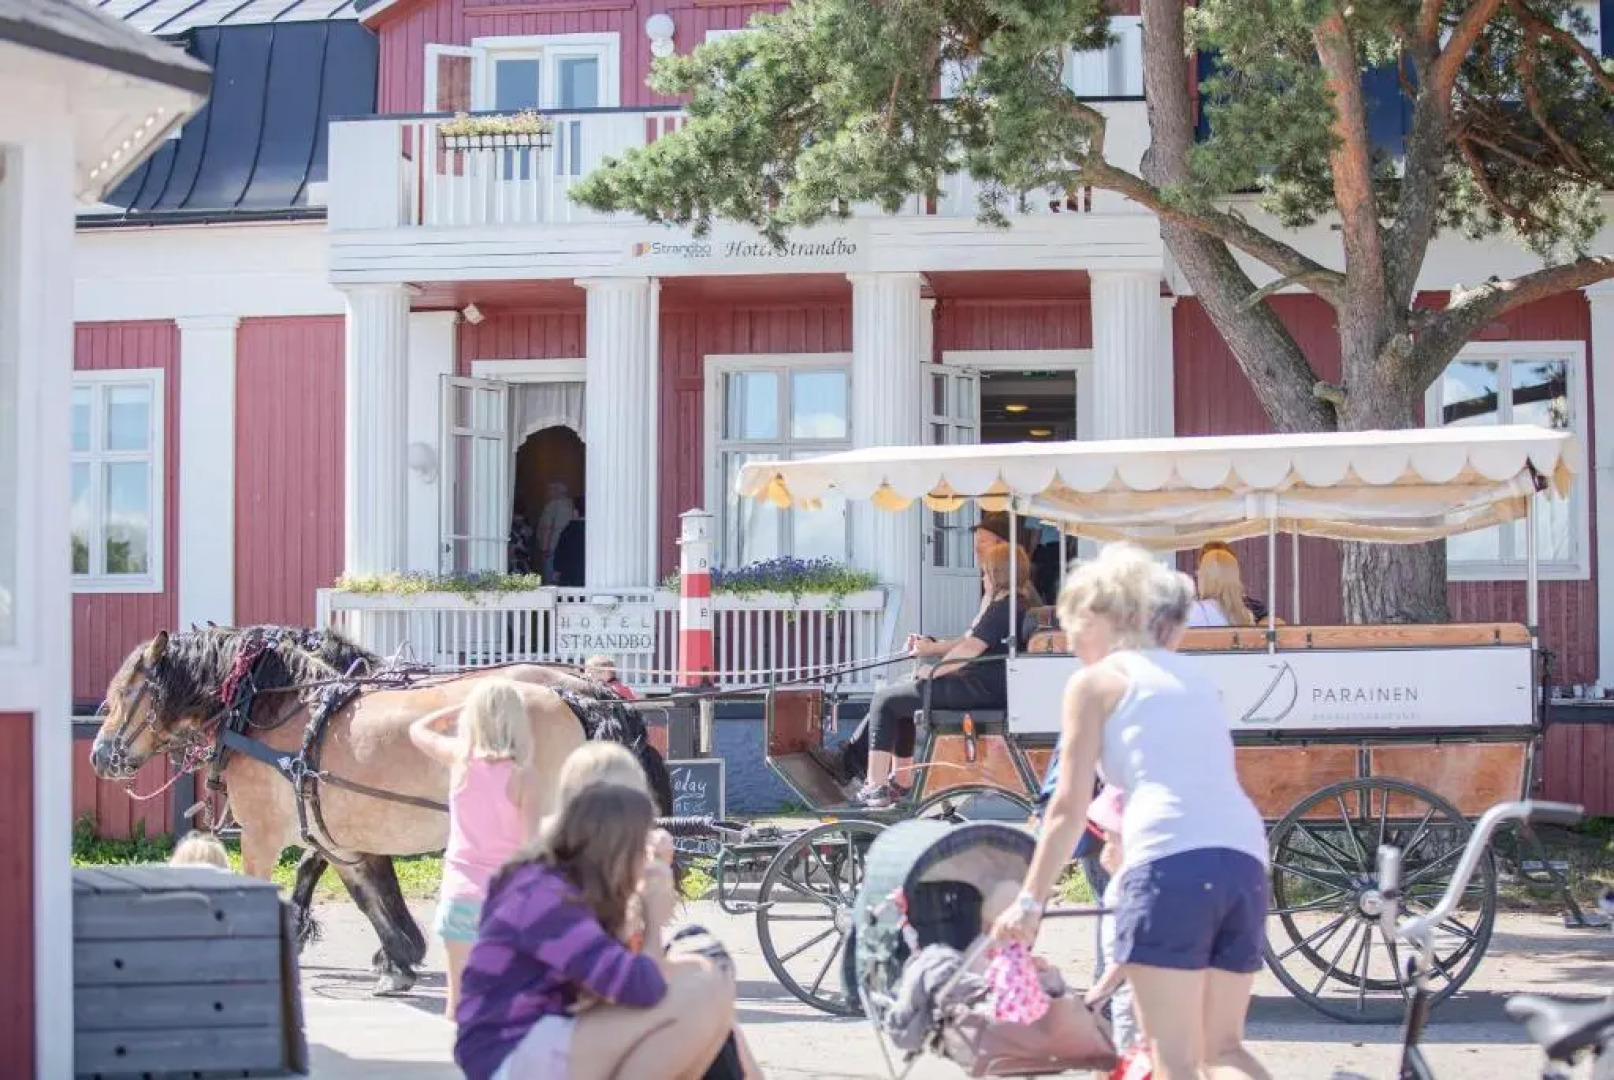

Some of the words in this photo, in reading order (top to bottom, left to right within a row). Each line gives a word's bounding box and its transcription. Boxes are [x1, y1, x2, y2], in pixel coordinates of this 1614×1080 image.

[561, 615, 651, 629] HOTEL
[560, 633, 652, 649] STRANDBO
[1312, 687, 1419, 702] PARAINEN
